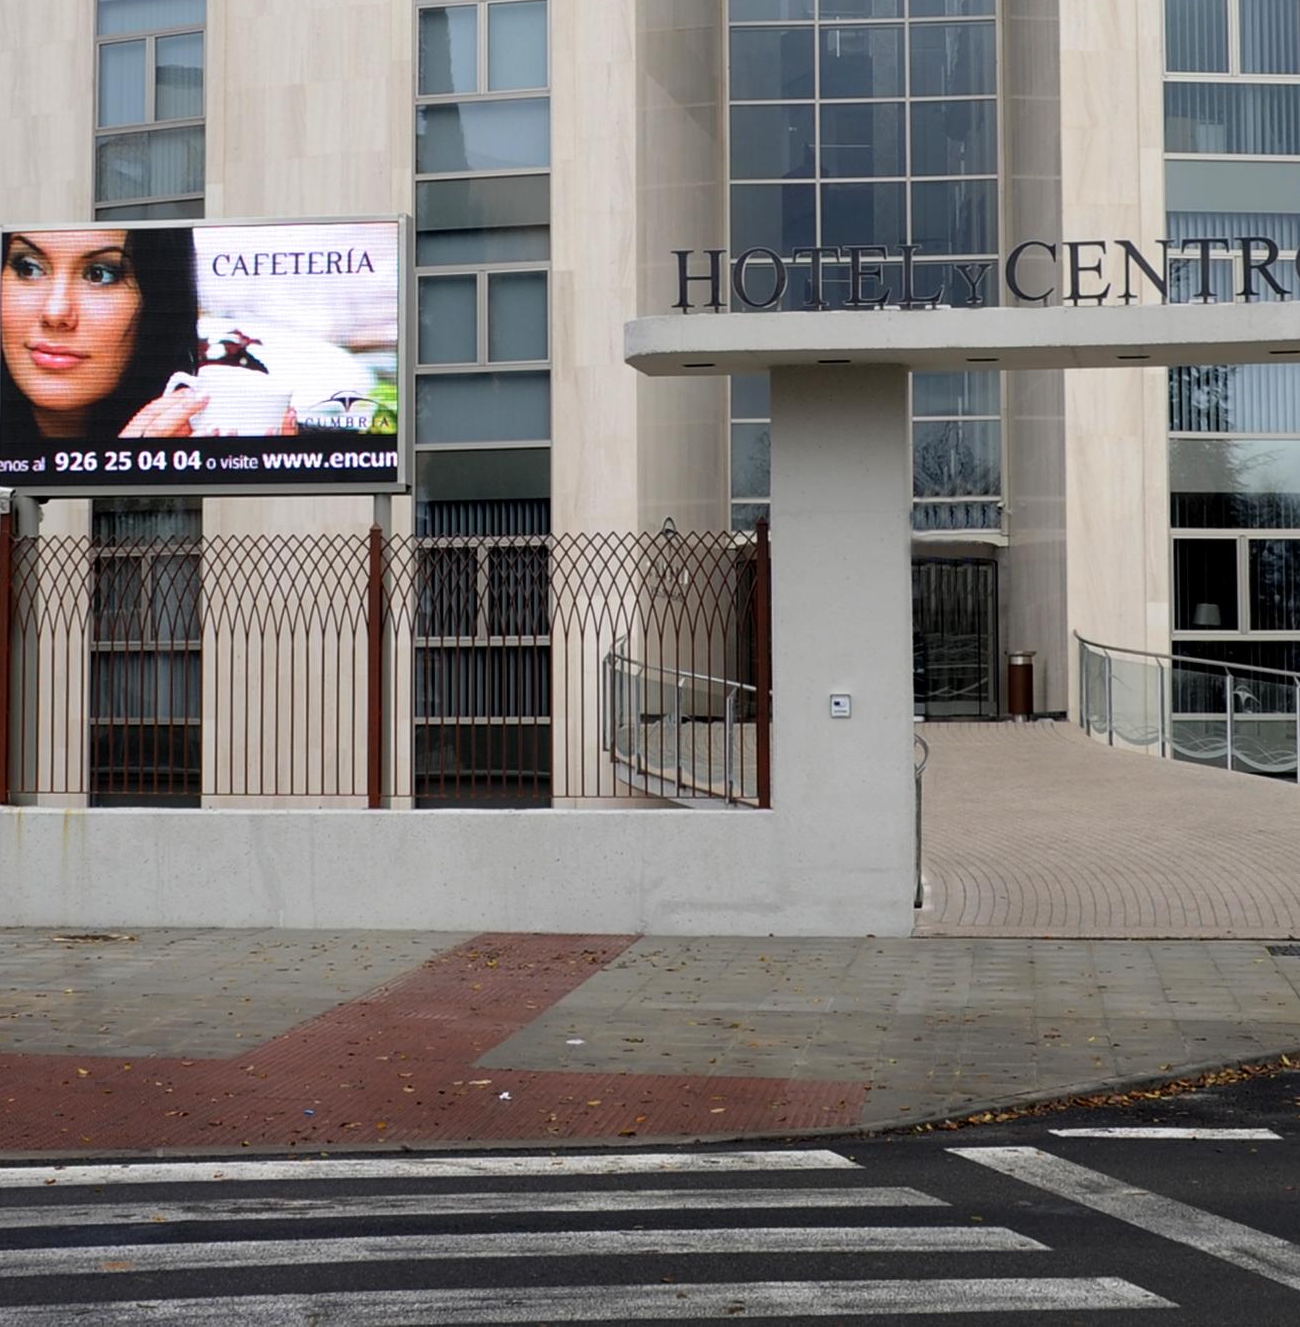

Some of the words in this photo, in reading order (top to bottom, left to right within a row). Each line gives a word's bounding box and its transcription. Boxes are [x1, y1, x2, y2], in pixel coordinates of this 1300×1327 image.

[212, 248, 375, 277] CAFETERÍA
[670, 243, 946, 309] HOTEL
[304, 416, 390, 428] CUMBRIA
[32, 456, 46, 472] al
[54, 451, 98, 472] 926
[104, 450, 132, 471] 25
[137, 450, 167, 471] 04
[172, 449, 202, 471] 04
[205, 458, 217, 470] o
[220, 455, 259, 470] visite
